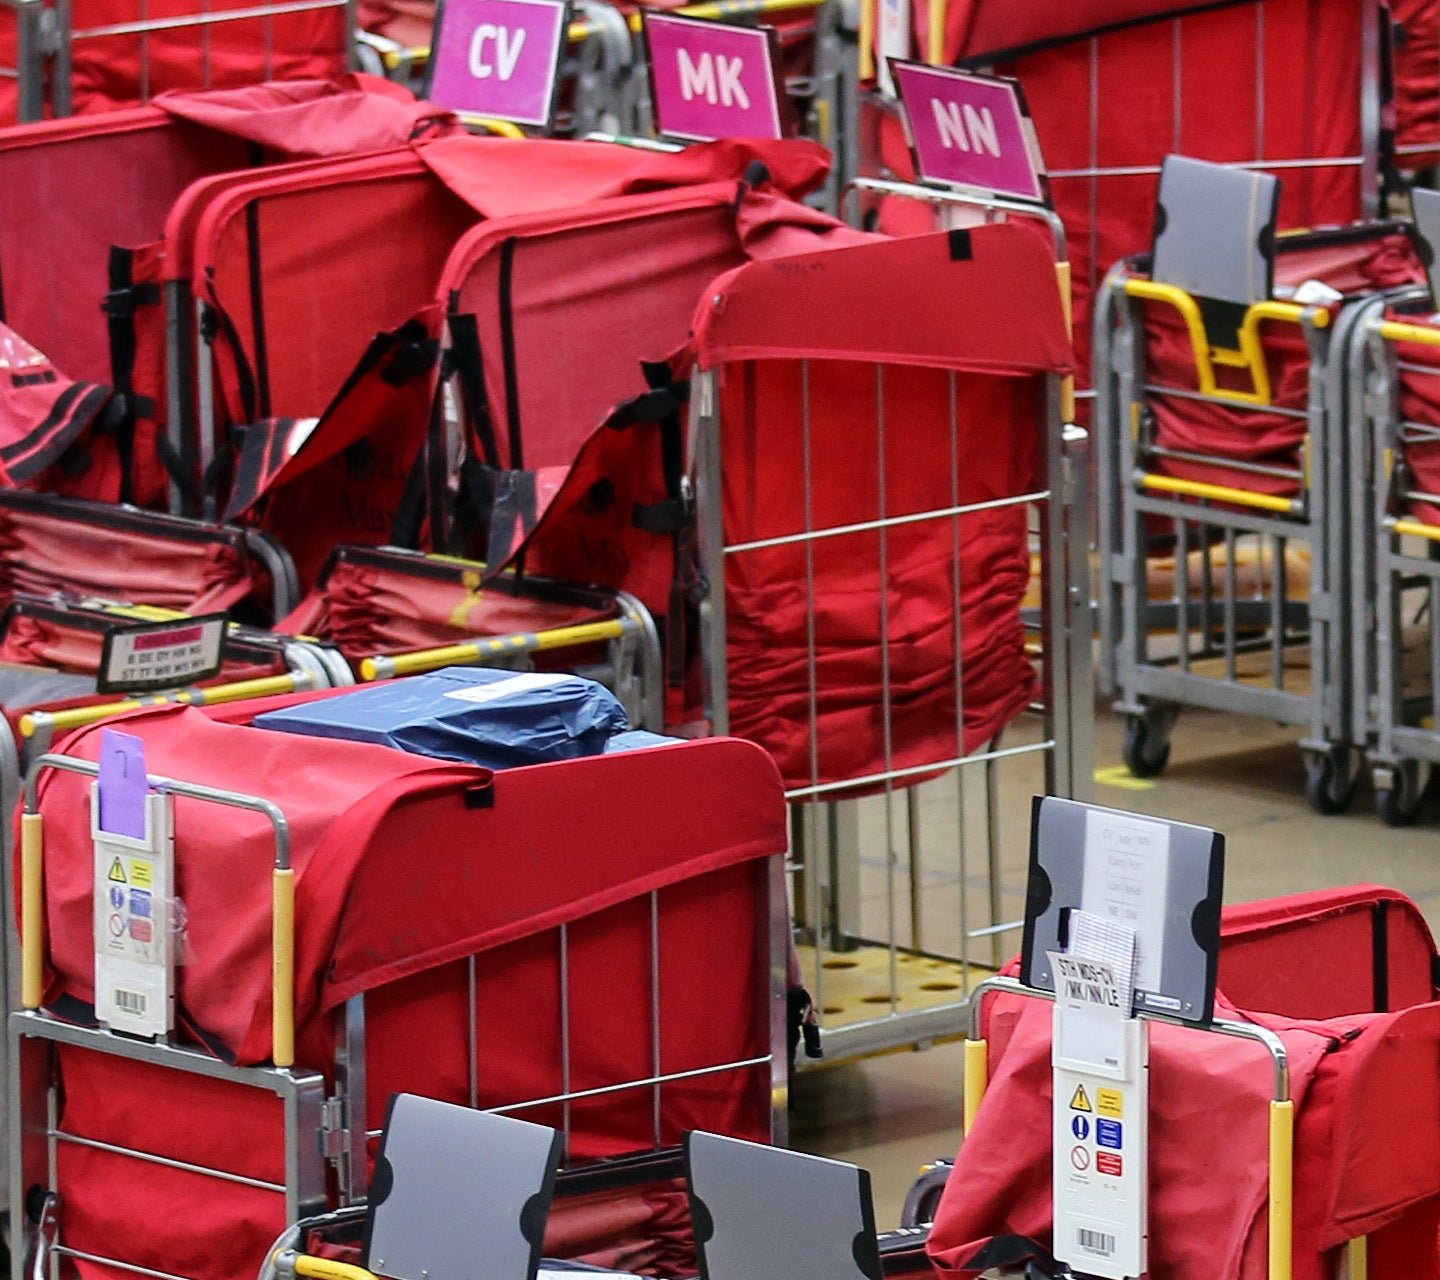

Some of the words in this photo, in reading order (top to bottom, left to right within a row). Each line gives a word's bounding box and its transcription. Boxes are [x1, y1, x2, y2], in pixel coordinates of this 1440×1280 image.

[468, 23, 527, 81] CV
[677, 48, 751, 110] MK
[931, 98, 1002, 158] NN
[1058, 958, 1079, 978] STH
